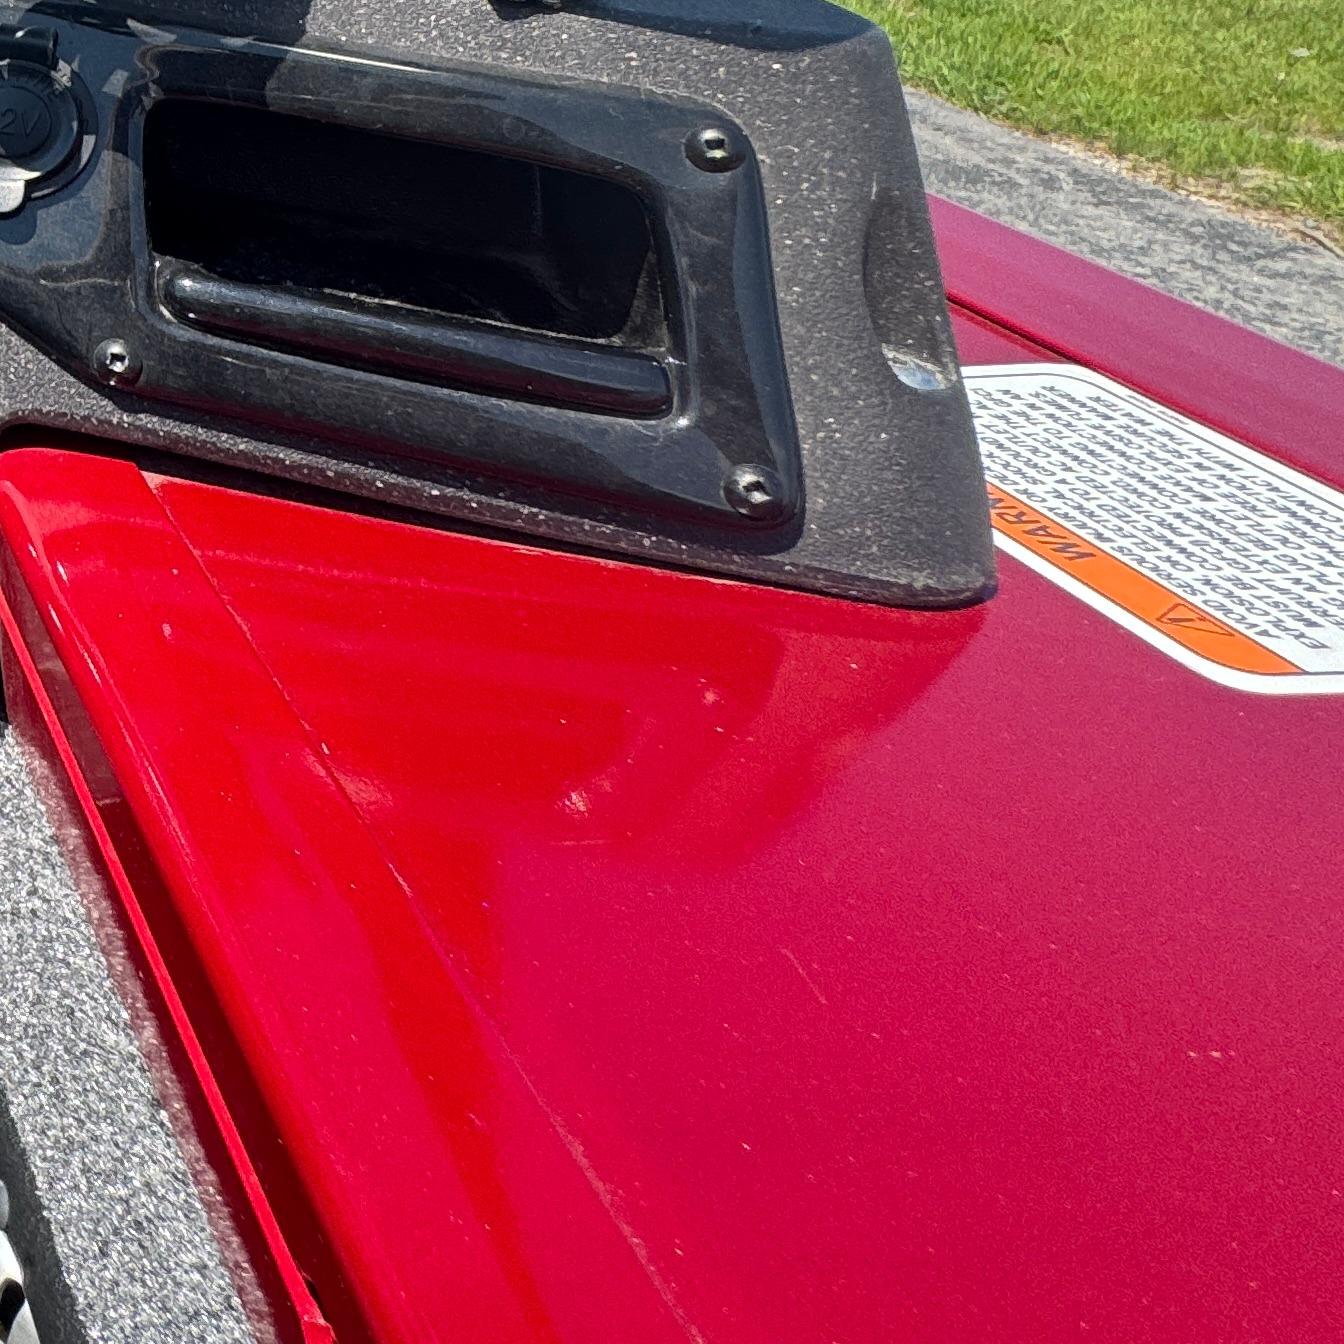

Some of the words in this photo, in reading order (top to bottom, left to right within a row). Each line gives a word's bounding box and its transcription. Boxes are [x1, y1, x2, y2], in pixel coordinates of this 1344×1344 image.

[971, 388, 1011, 407] GFCI
[997, 389, 1024, 400] AN
[1041, 386, 1116, 420] MANNER
[989, 413, 1025, 429] THE
[1007, 410, 1044, 425] THE
[1087, 396, 1152, 426] WATER
[1043, 427, 1071, 440] TO
[1043, 413, 1157, 470] CONNECTION
[1087, 424, 1189, 472] EXPLOSIVE
[1115, 424, 1191, 459] SECURE
[1150, 429, 1189, 445] THE
[1022, 432, 1109, 475] CONNECT
[1047, 461, 1078, 472] AC
[1188, 448, 1242, 471] WITH
[1069, 442, 1190, 504] CONNECTING
[1155, 474, 1216, 501] MAKE
[1185, 476, 1219, 488] OF
[1013, 488, 1047, 502] OR
[1068, 487, 1099, 501] TO
[1075, 476, 1191, 536] PROTECTED
[1215, 492, 1276, 518] FREE
[989, 496, 1097, 561] WARN
[1043, 506, 1114, 542] INJURY
[1045, 488, 1159, 551] ELECTRICAL
[1188, 508, 1277, 550] BEFORE
[1097, 504, 1221, 570] CONNECTED
[1167, 512, 1288, 573] EXTENSION
[1111, 546, 1205, 595] SERIOUS
[1155, 555, 1193, 571] OR
[1274, 554, 1342, 585] PLUG
[1301, 553, 1342, 568] AC
[1217, 575, 1257, 590] BE
[1284, 577, 1326, 593] AN
[1202, 599, 1279, 638] AVOID
[1251, 594, 1323, 627] MUST
